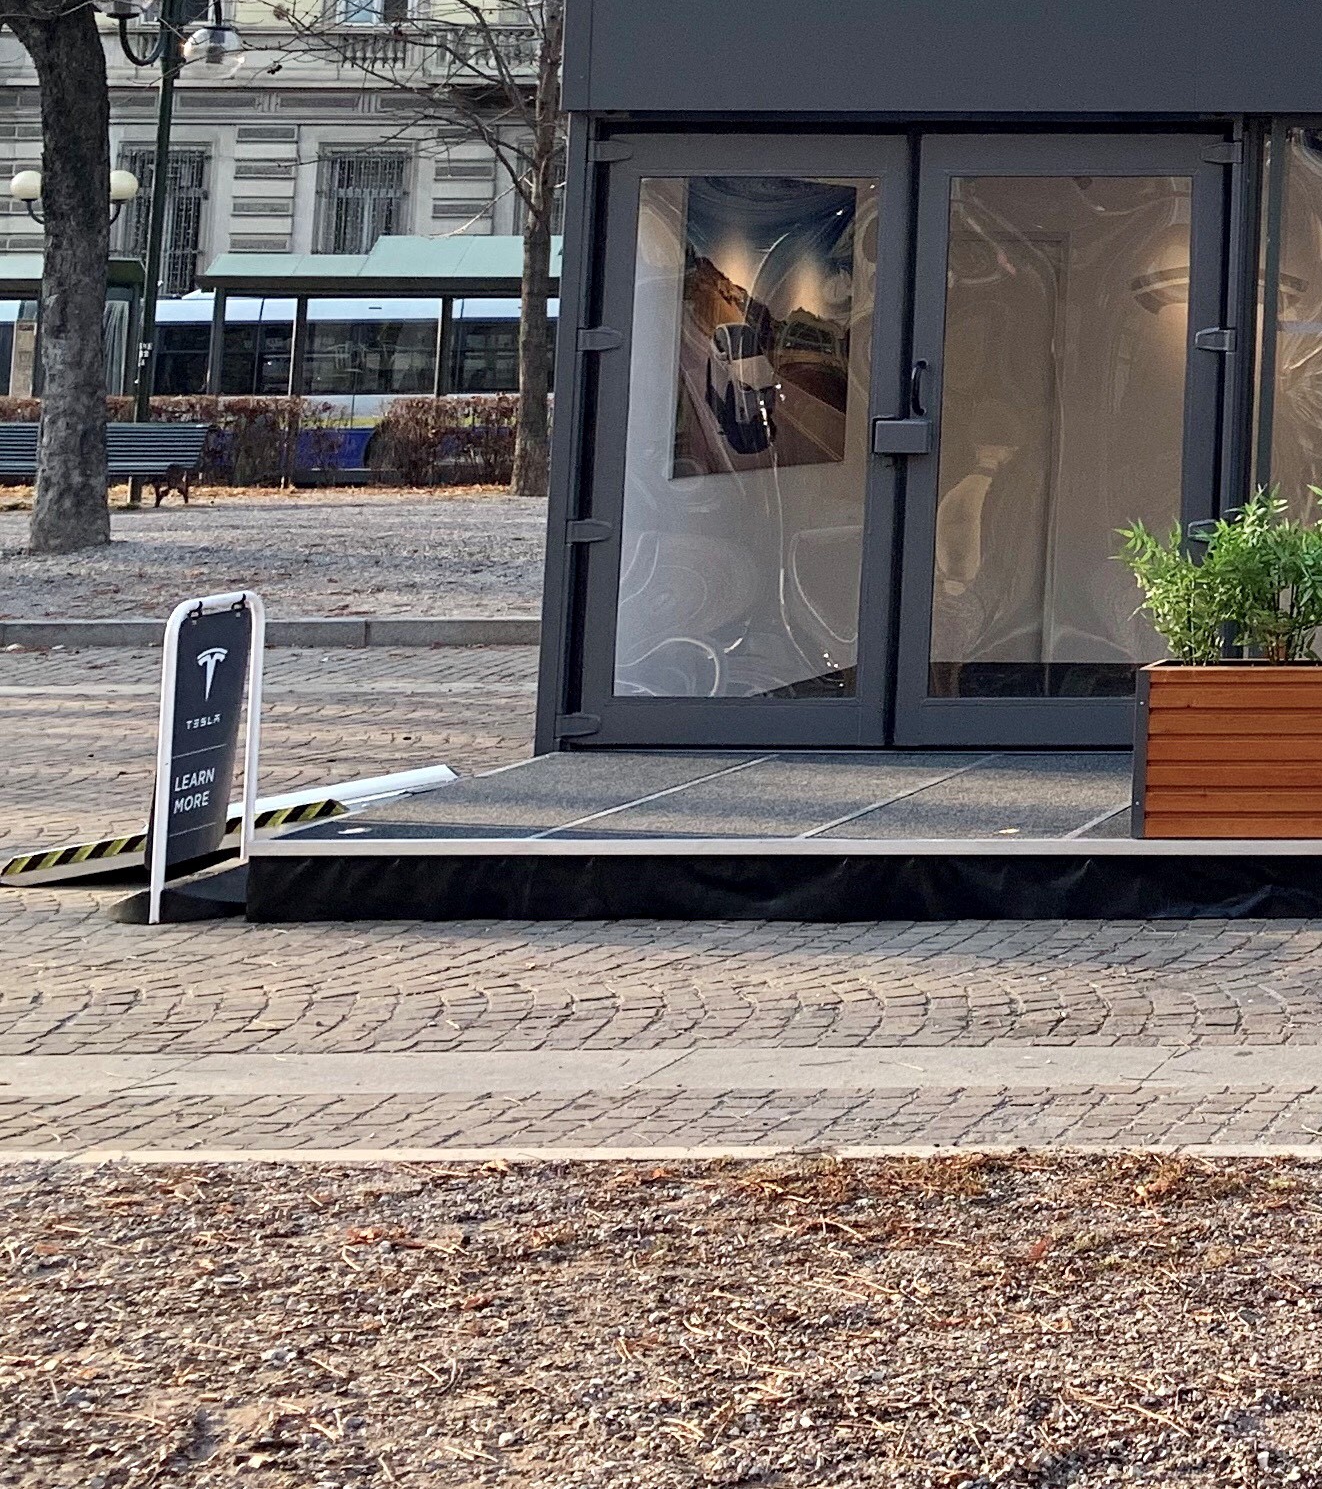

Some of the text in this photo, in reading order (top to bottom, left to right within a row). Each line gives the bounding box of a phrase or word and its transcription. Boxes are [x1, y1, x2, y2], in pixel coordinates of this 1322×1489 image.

[186, 714, 220, 729] TESLA
[174, 767, 215, 792] LEARN
[173, 790, 210, 814] MORE
